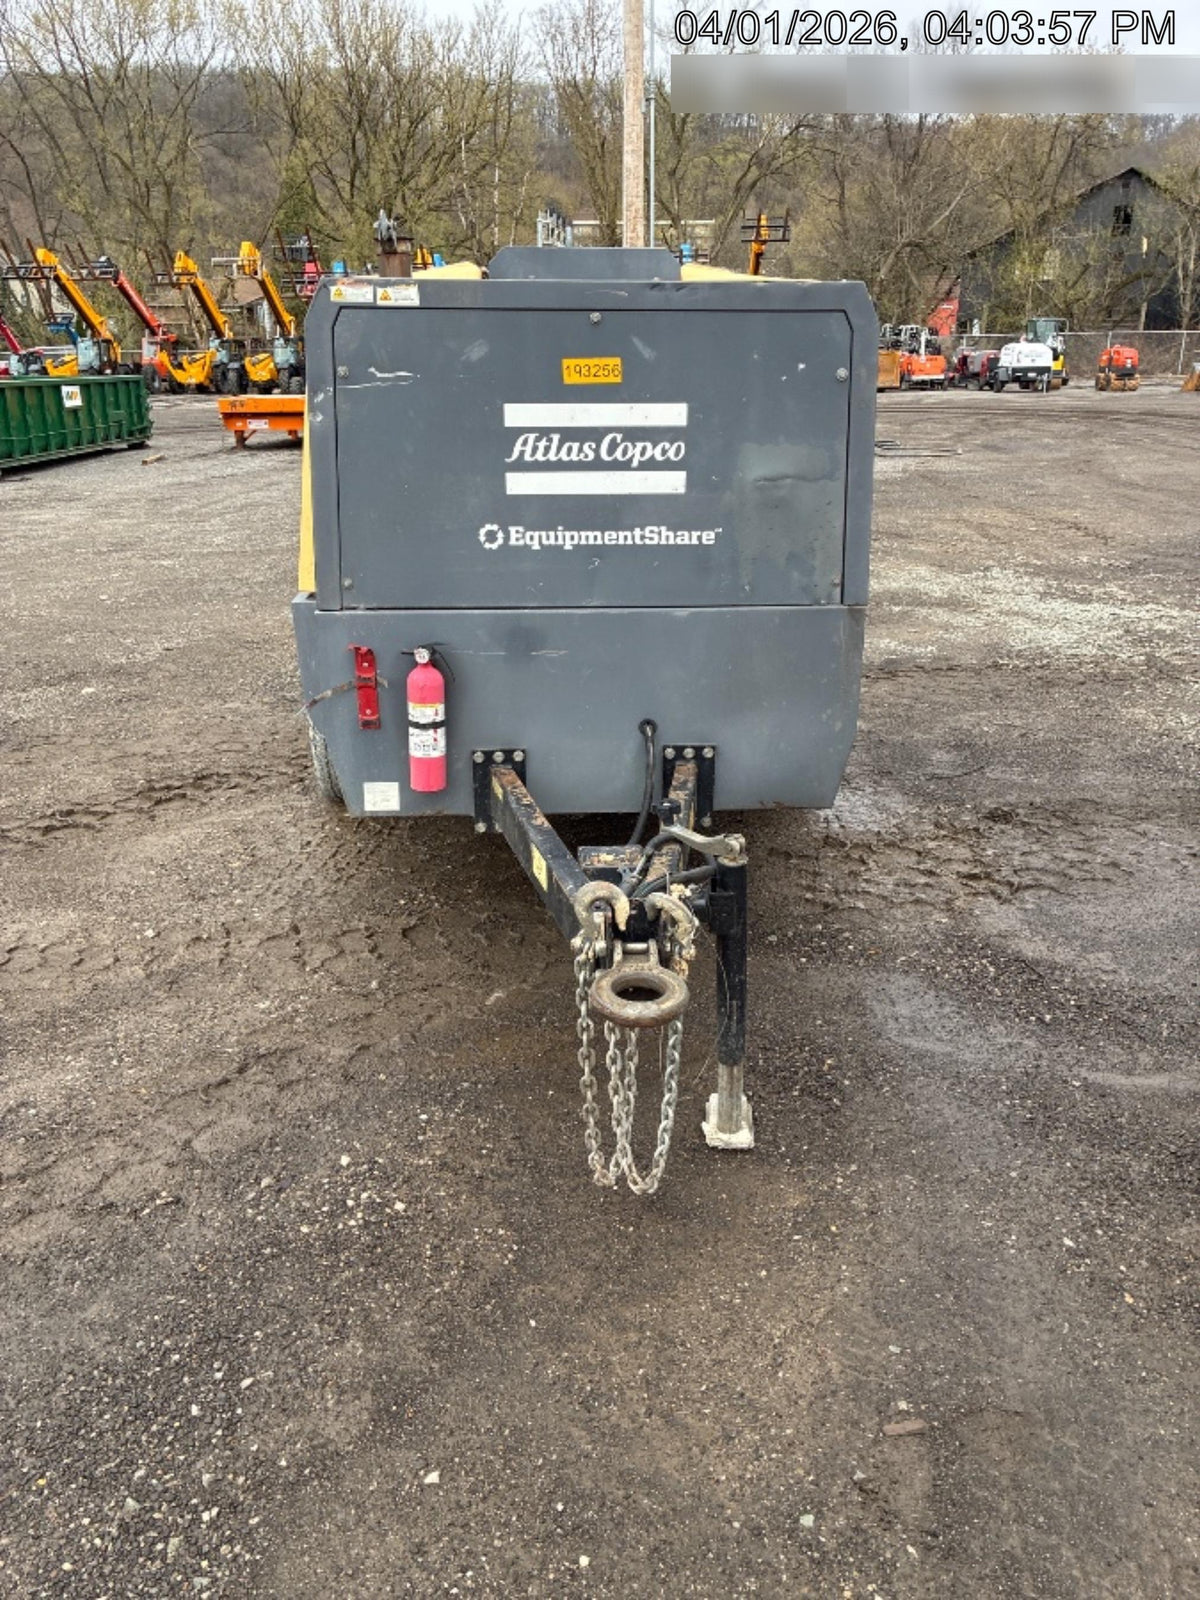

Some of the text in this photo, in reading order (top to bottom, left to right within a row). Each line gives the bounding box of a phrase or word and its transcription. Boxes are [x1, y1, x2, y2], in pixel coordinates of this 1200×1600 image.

[565, 363, 621, 378] 193256
[505, 432, 686, 468] Atlas Copco
[507, 525, 716, 550] EquipmentShare
